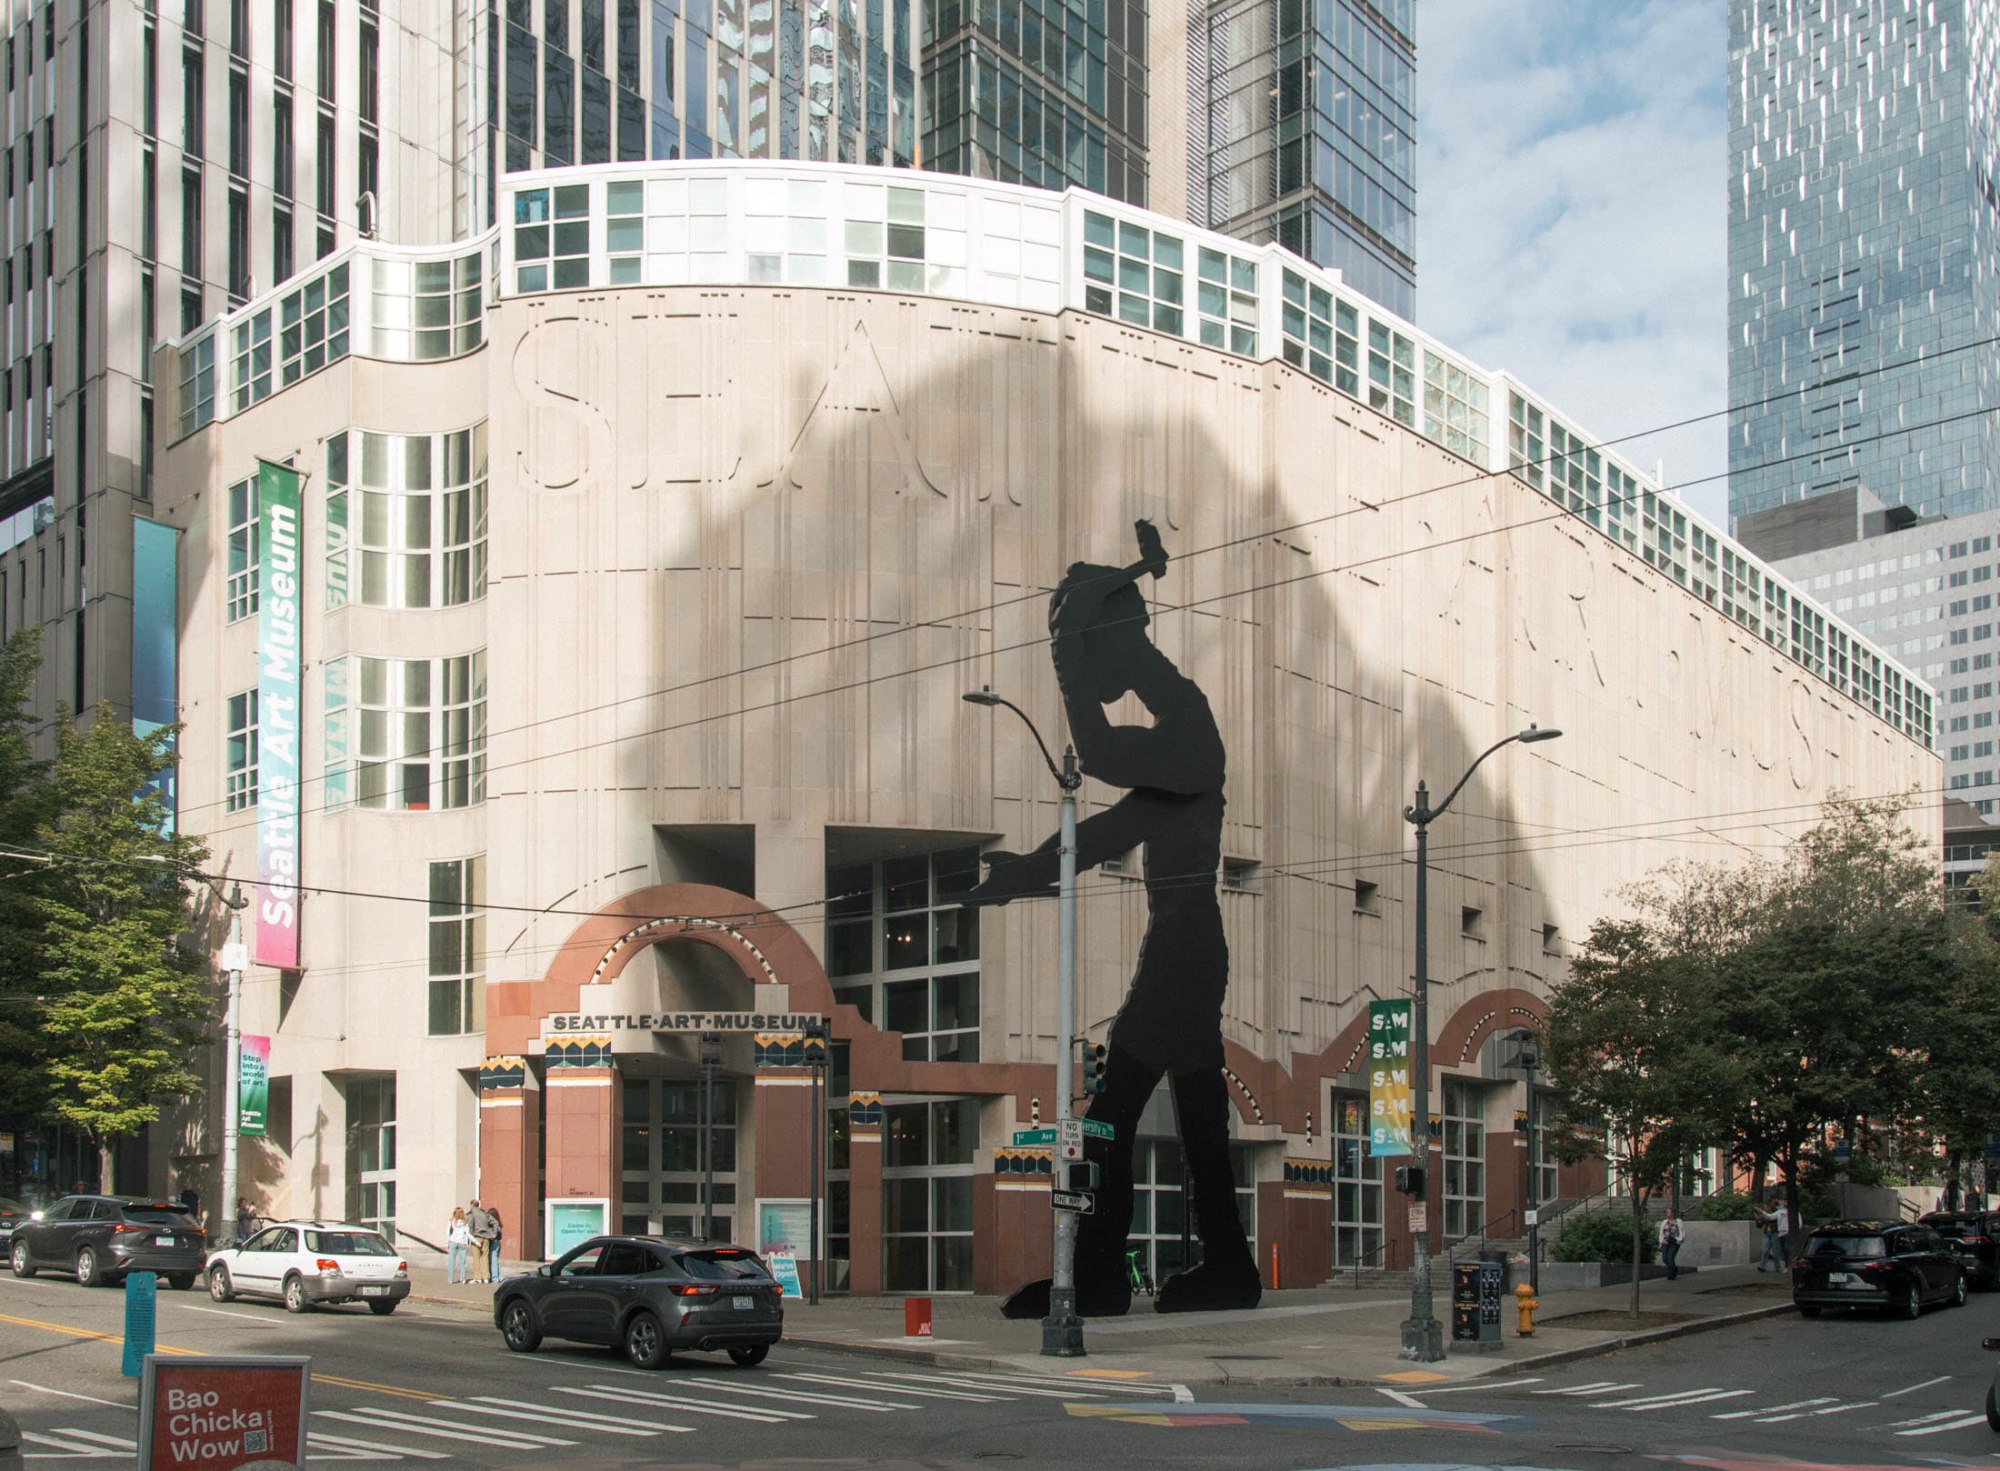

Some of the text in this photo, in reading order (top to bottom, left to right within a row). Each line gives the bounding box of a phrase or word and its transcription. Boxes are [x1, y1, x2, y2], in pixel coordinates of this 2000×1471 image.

[262, 505, 296, 928] Seattle Art Museum
[553, 1015, 819, 1030] SEATTLE ART MUSEUM
[242, 1054, 261, 1062] Step
[242, 1062, 258, 1070] into
[1066, 1122, 1077, 1131] NO
[1042, 1132, 1053, 1141] Ave
[1056, 1195, 1081, 1205] ONE WAY
[168, 1389, 219, 1411] Bao
[169, 1408, 263, 1437] Chicka
[170, 1439, 240, 1463] Wow
